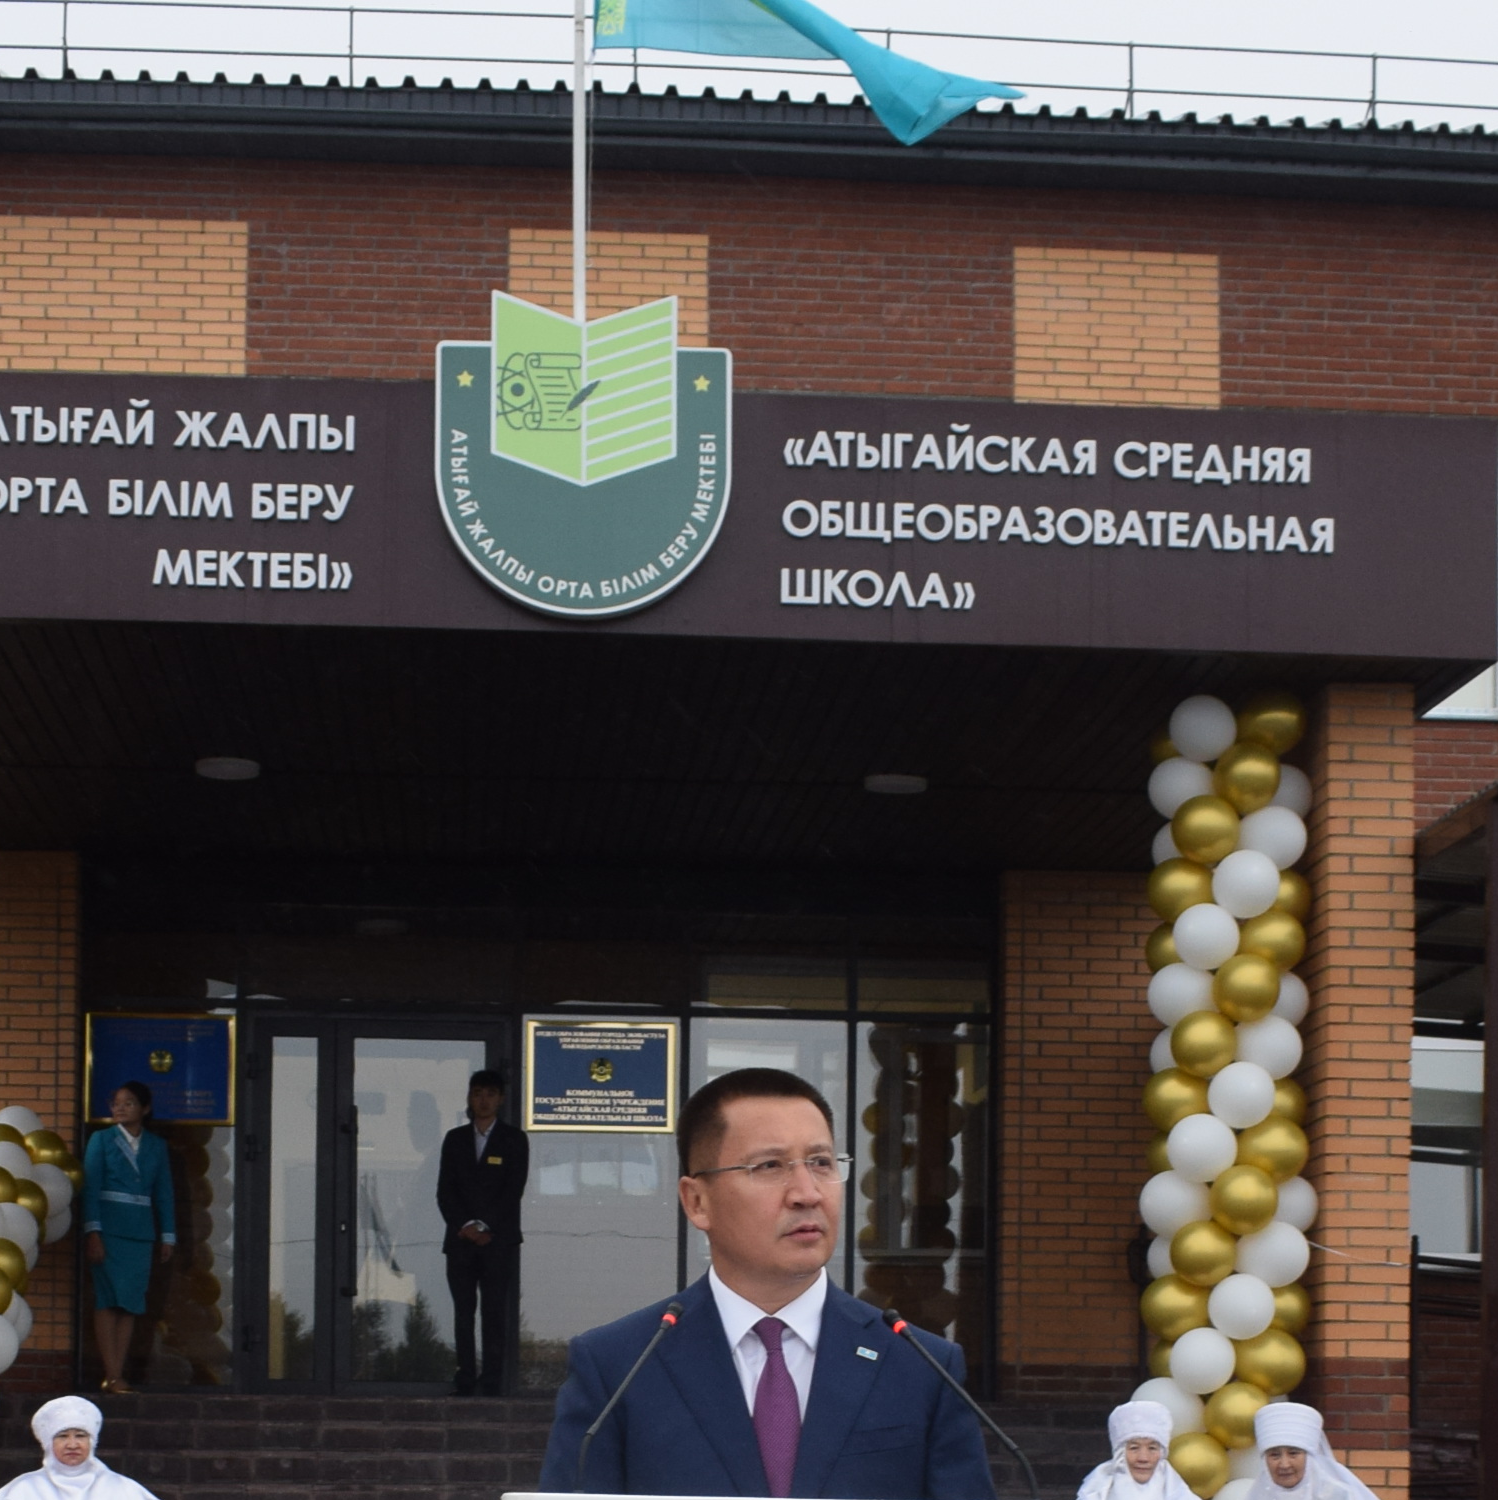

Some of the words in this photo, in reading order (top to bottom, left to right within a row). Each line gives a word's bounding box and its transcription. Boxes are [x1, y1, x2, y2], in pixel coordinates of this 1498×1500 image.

[173, 410, 355, 452] ЖАЛПЫ
[783, 423, 1097, 475] «АТЫГАЙСКАЯ
[1114, 441, 1311, 485] СРЕДНЯЯ
[108, 478, 233, 519] БІЛІМ
[251, 482, 354, 521] БЕРУ
[450, 428, 479, 518] АТЫҒАЙ
[466, 518, 535, 585] ЖАЛПЫ
[537, 575, 594, 599] ОРТА
[600, 563, 661, 598] БІЛІМ
[659, 522, 699, 569] БЕРУ
[690, 433, 717, 523] МЕКТЕБІ
[782, 499, 1335, 553] ОБЩЕОБРАЗОВАТЕЛЬНАЯ
[152, 548, 353, 590] МЕКТЕБІ»
[780, 567, 976, 609] ШКОЛА»
